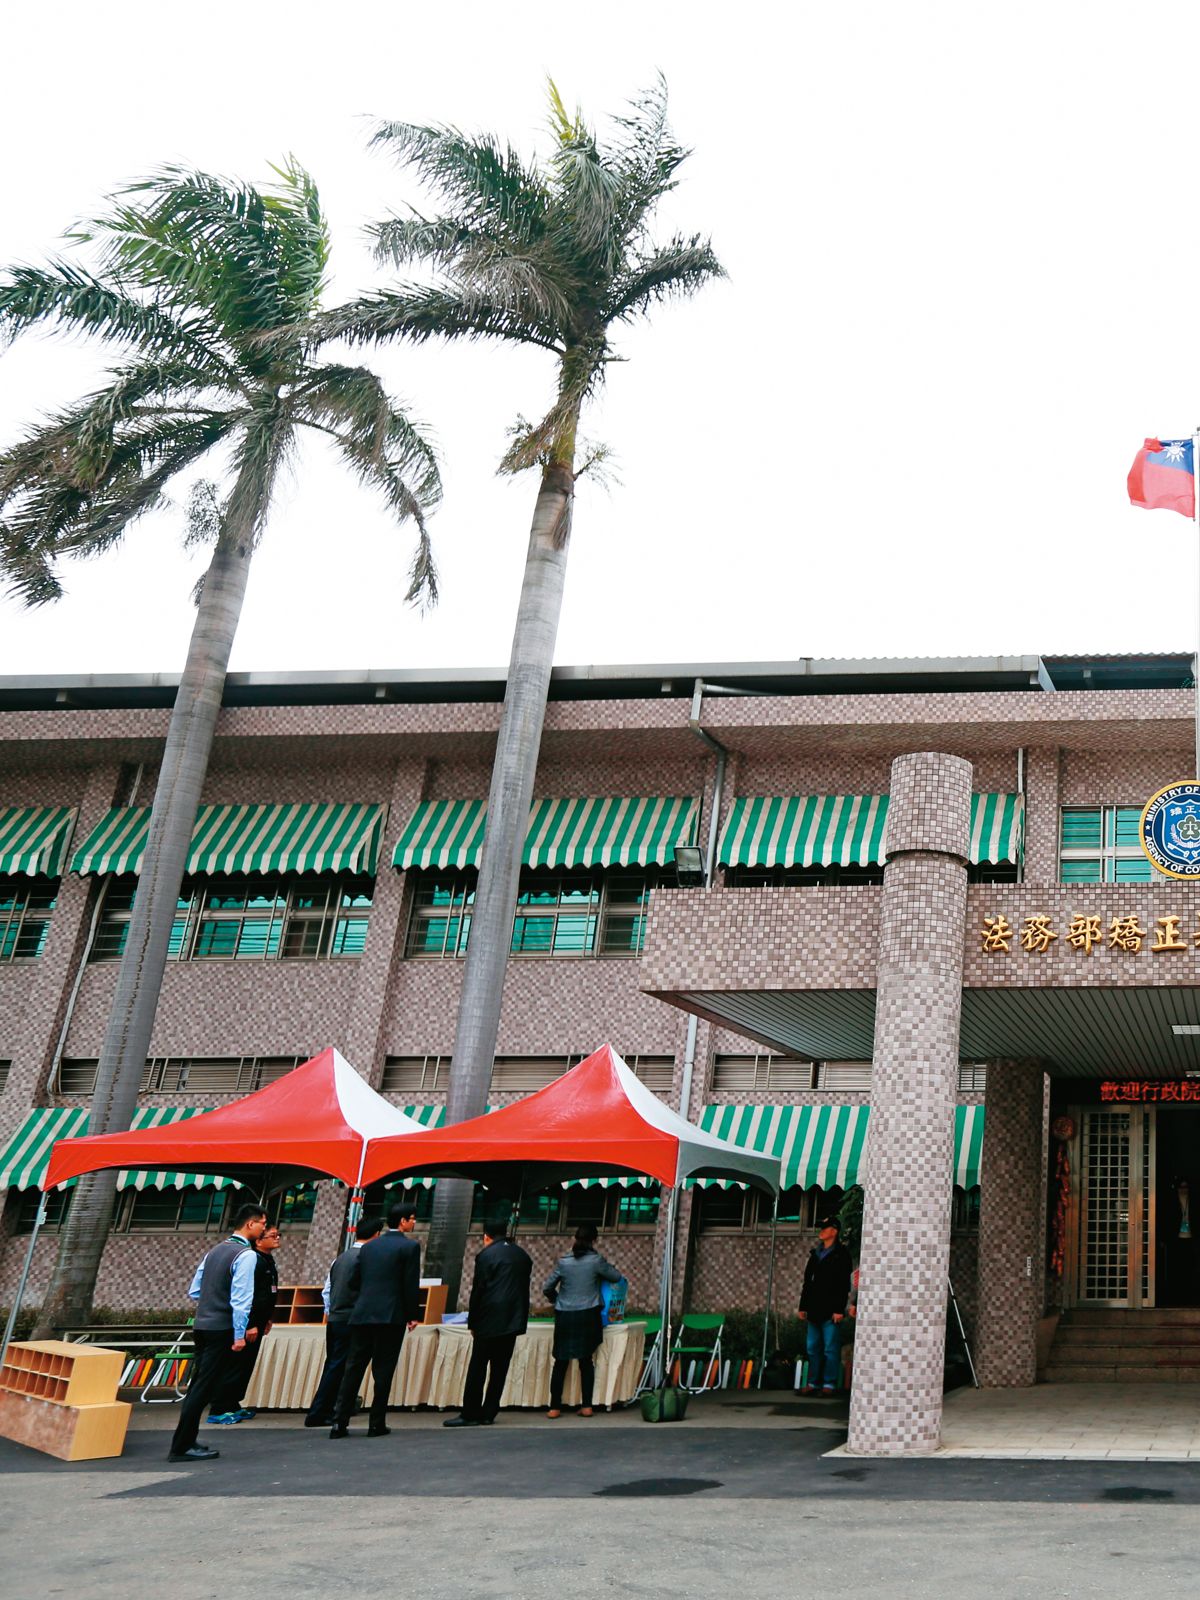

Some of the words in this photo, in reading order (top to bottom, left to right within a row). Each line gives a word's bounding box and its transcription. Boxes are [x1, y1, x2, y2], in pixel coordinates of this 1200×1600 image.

[1146, 786, 1182, 821] MINISTRY
[1185, 786, 1199, 794] OF
[1145, 835, 1171, 868] AGENCY
[1170, 863, 1184, 873] OF
